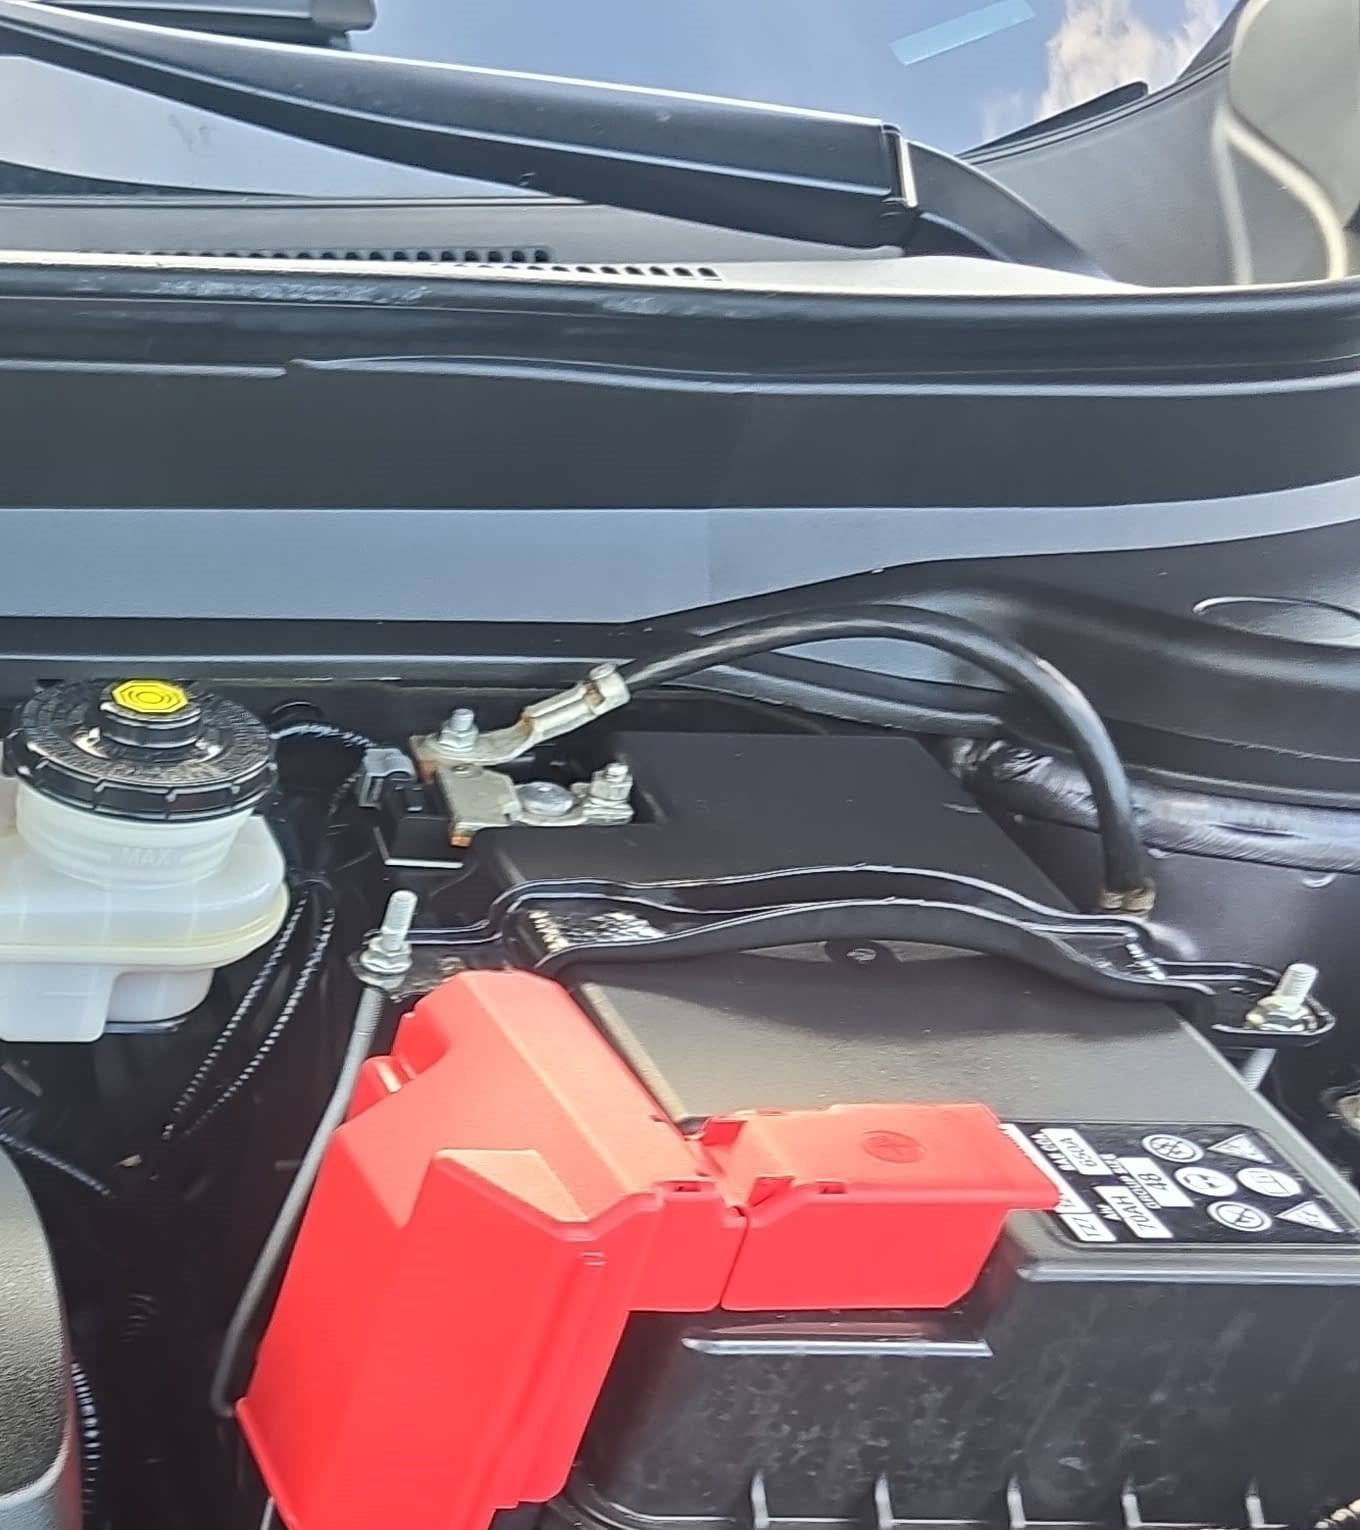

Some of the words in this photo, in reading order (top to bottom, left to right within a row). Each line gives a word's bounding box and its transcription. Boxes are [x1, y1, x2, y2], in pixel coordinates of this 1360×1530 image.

[119, 846, 172, 866] MAX
[1059, 1136, 1098, 1168] 650A
[1118, 1174, 1162, 1210] GROUP
[1137, 1172, 1168, 1193] 48
[1111, 1194, 1157, 1230] 70AH
